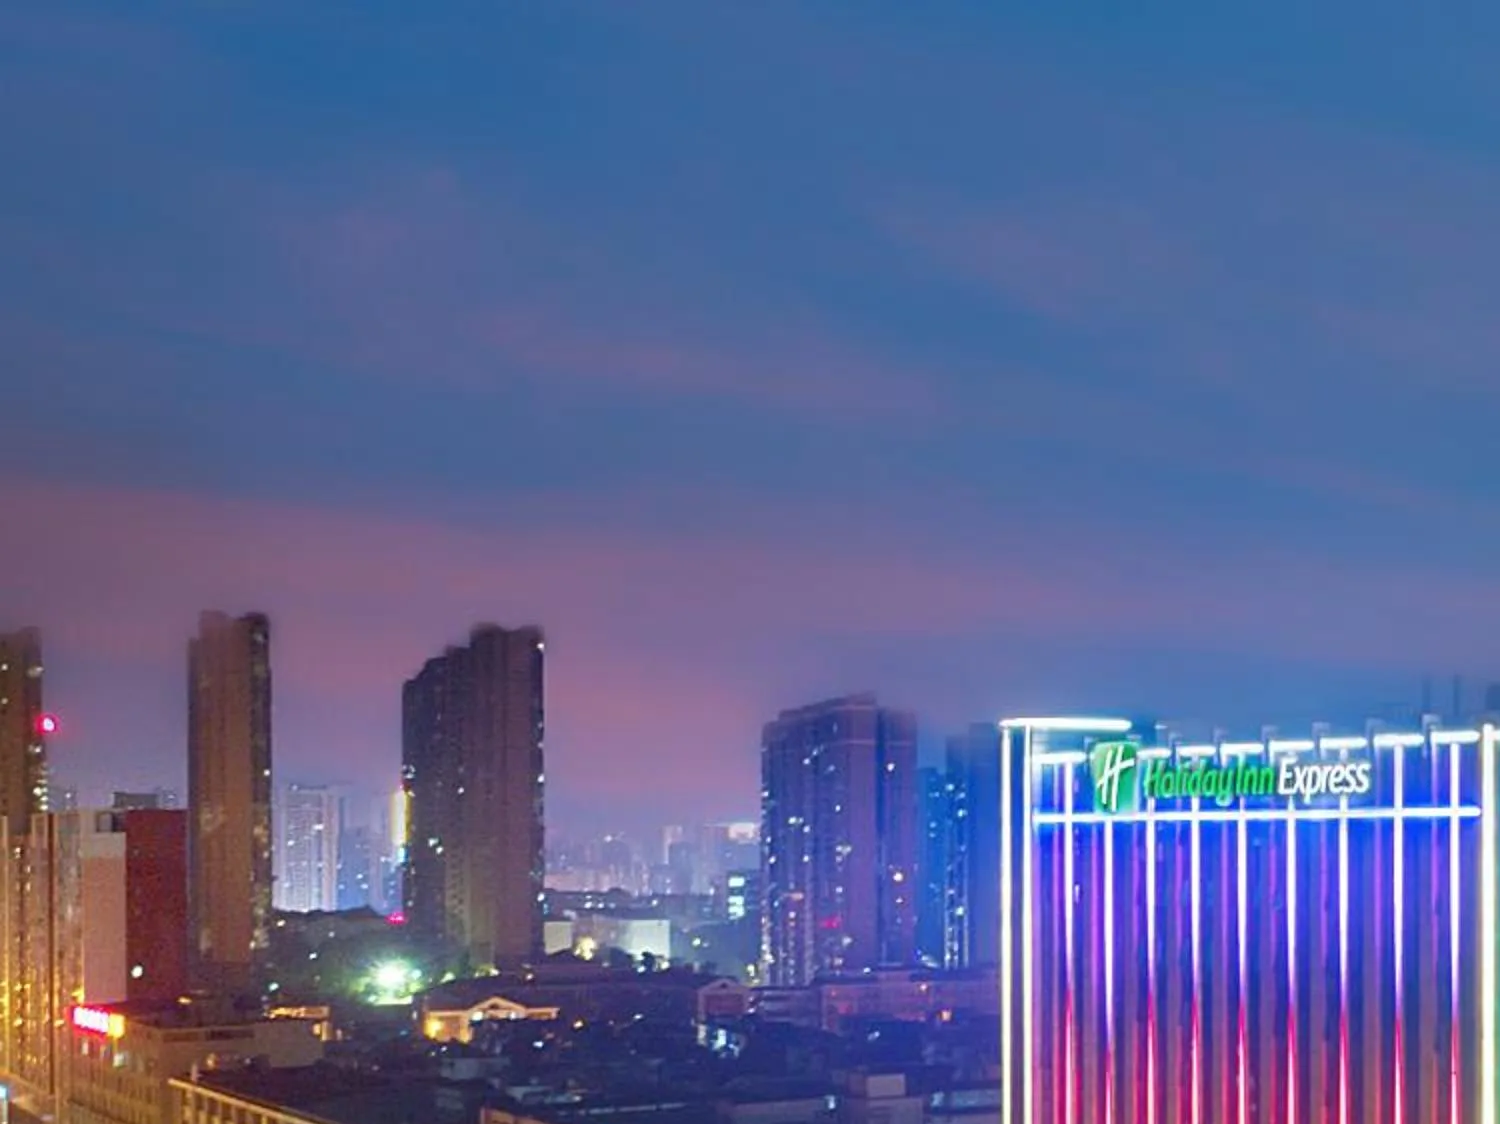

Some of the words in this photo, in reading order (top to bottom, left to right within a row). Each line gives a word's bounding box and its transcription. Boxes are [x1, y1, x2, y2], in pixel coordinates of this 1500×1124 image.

[1143, 758, 1234, 807] Holiday
[1235, 754, 1275, 796] Inn
[1278, 756, 1371, 805] Express
